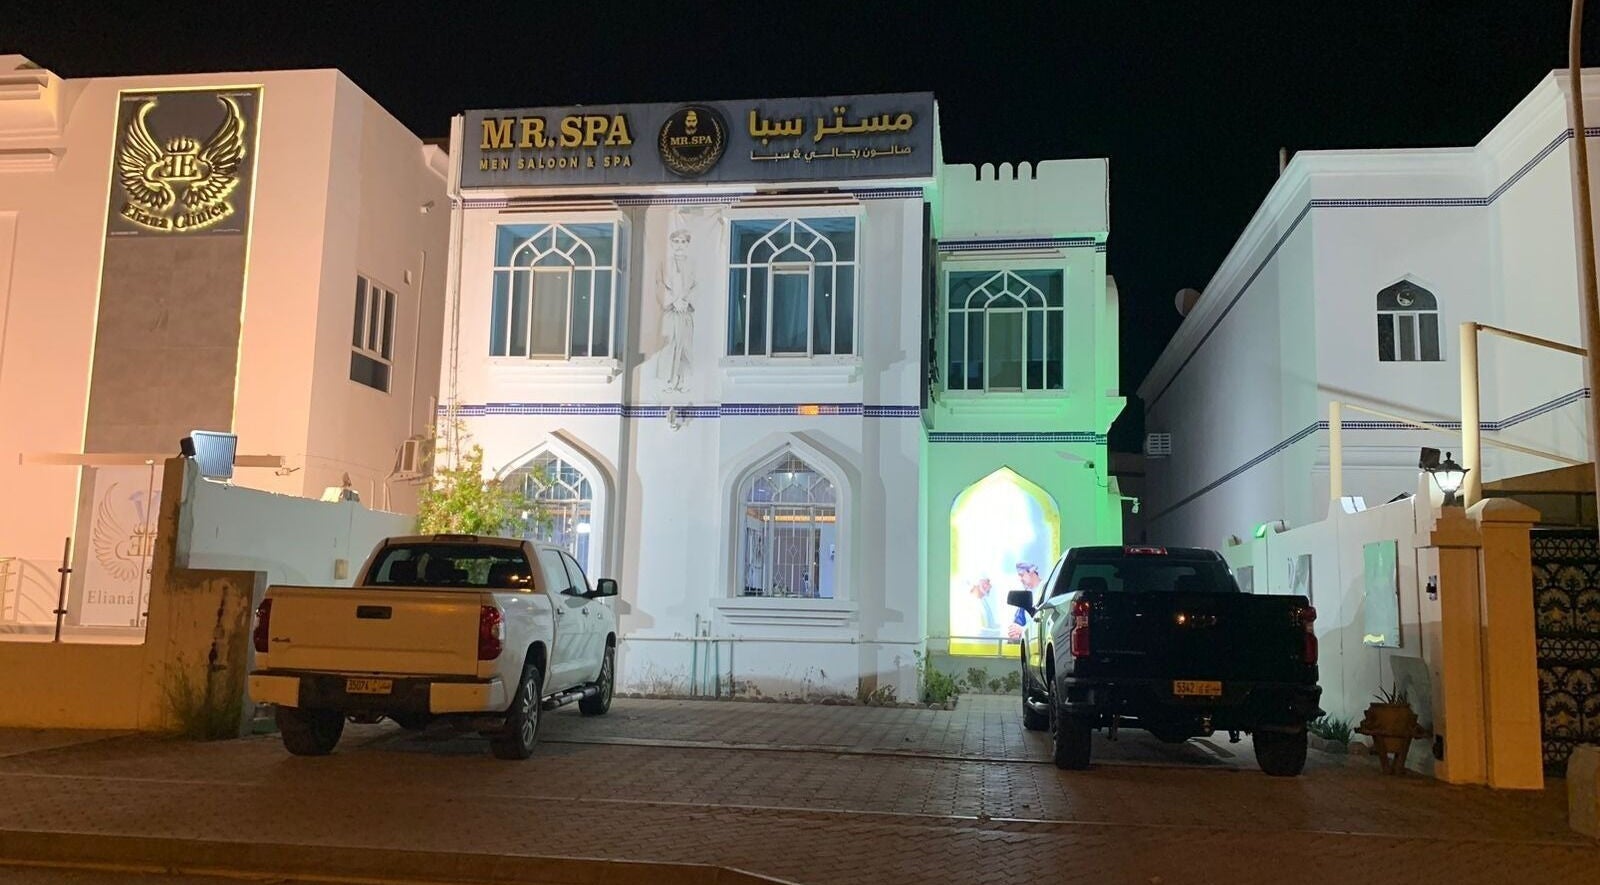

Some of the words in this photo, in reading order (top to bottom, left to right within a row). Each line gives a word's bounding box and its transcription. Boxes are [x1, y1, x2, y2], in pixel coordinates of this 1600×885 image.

[749, 110, 803, 145] سبا
[813, 106, 913, 144] مستر
[480, 158, 509, 170] MEN
[518, 156, 579, 169] SALOON
[586, 156, 596, 168] &
[603, 155, 632, 168] SPA
[792, 148, 801, 160] &
